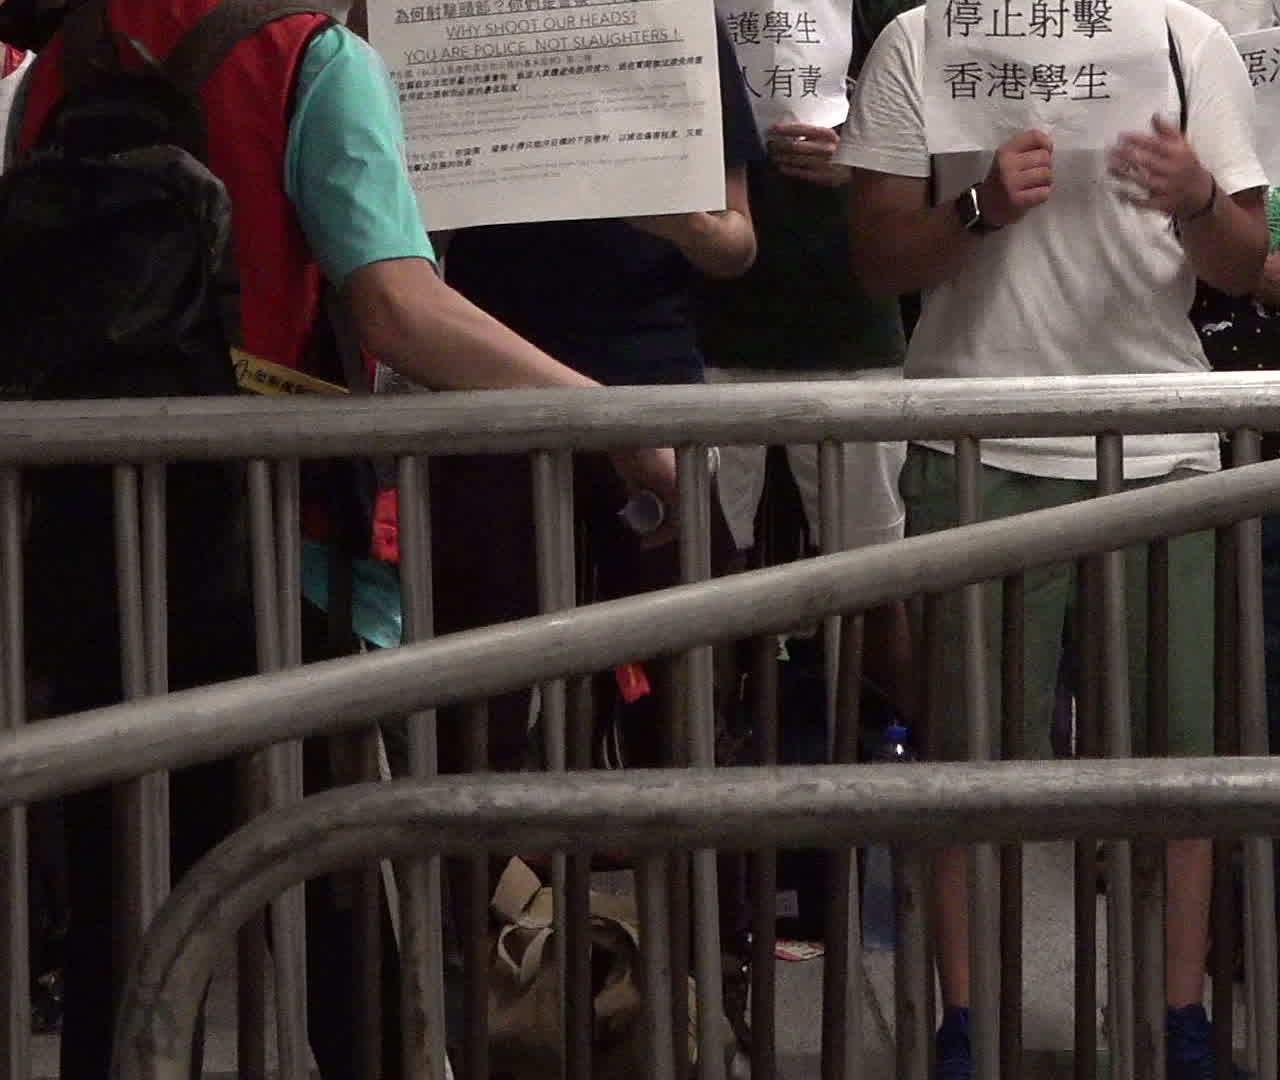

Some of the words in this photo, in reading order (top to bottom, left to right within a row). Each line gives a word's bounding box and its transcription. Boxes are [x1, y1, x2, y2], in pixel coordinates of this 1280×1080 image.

[446, 23, 481, 39] WHY
[485, 18, 537, 36] SHOOT
[542, 14, 576, 31] OUR
[579, 9, 638, 27] HEADS?
[726, 11, 821, 45] 護學生
[403, 48, 437, 64] YOU
[441, 46, 470, 60] ARE
[535, 36, 569, 52] NOT
[944, 62, 1111, 102] 香港學生
